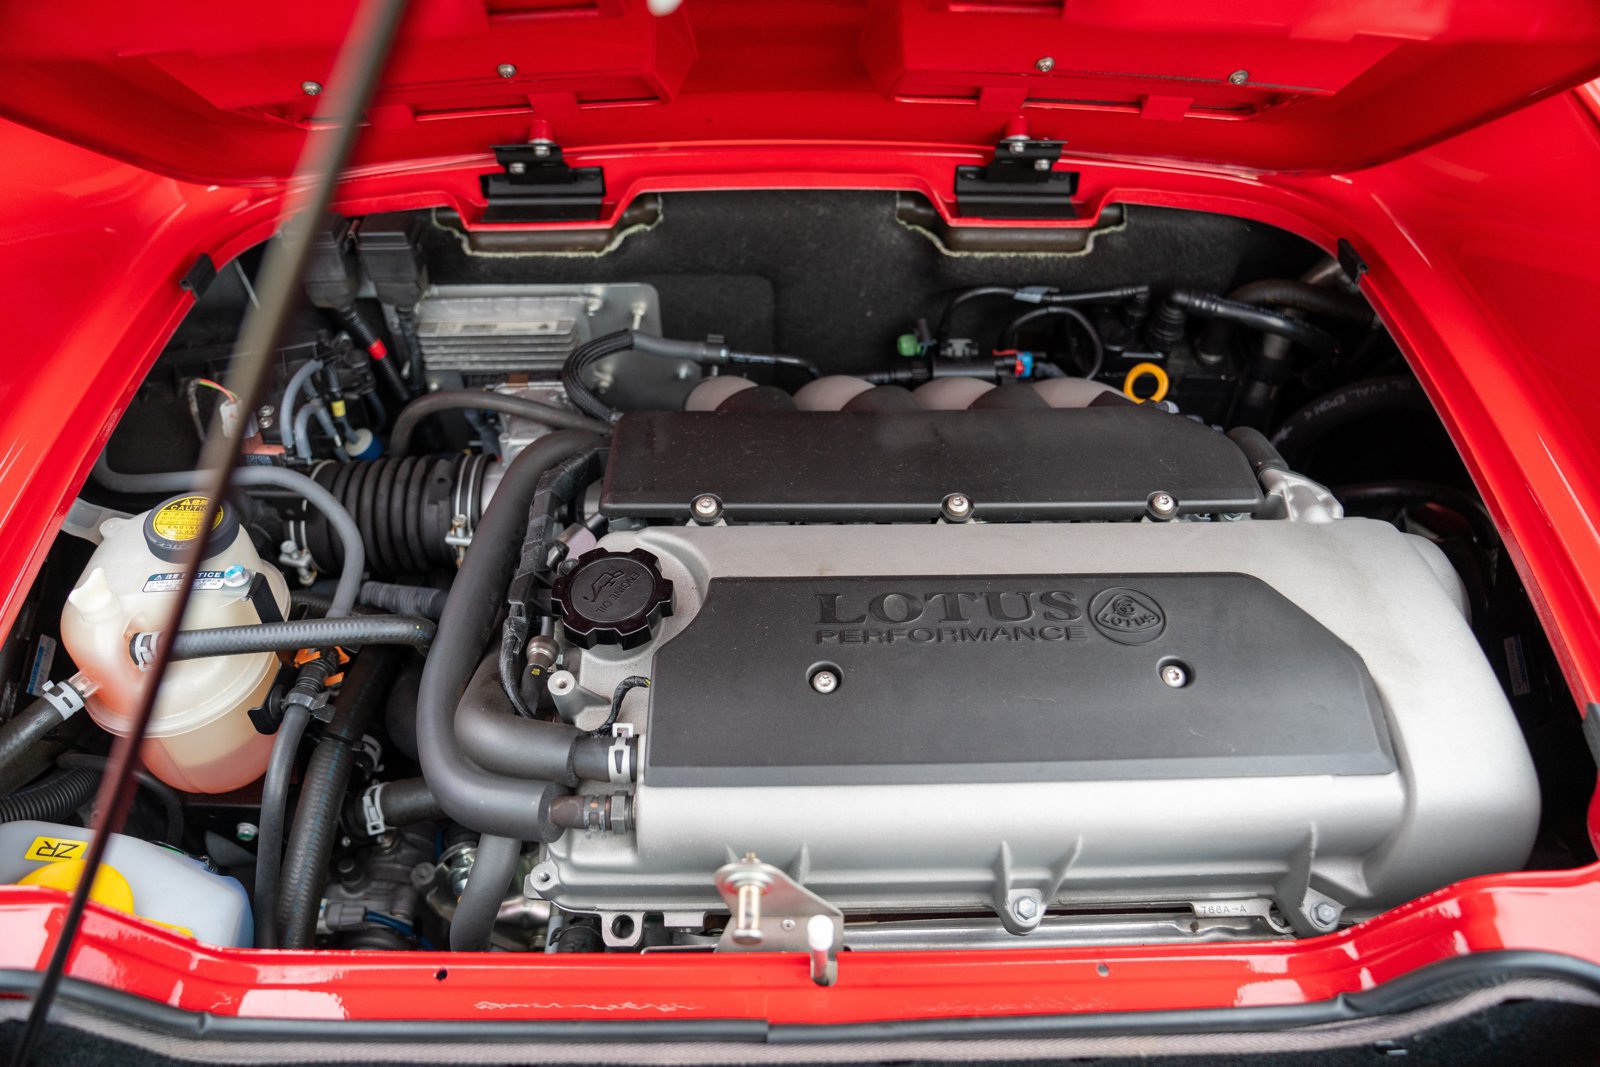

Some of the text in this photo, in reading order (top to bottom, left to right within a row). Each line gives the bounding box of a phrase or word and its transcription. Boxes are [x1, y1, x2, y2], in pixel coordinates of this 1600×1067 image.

[595, 571, 640, 613] ENGINE OIL
[815, 591, 1082, 625] LOTUS
[1101, 613, 1155, 627] LOTUS
[816, 625, 1088, 645] PERFORMANCE
[36, 841, 80, 859] ZR
